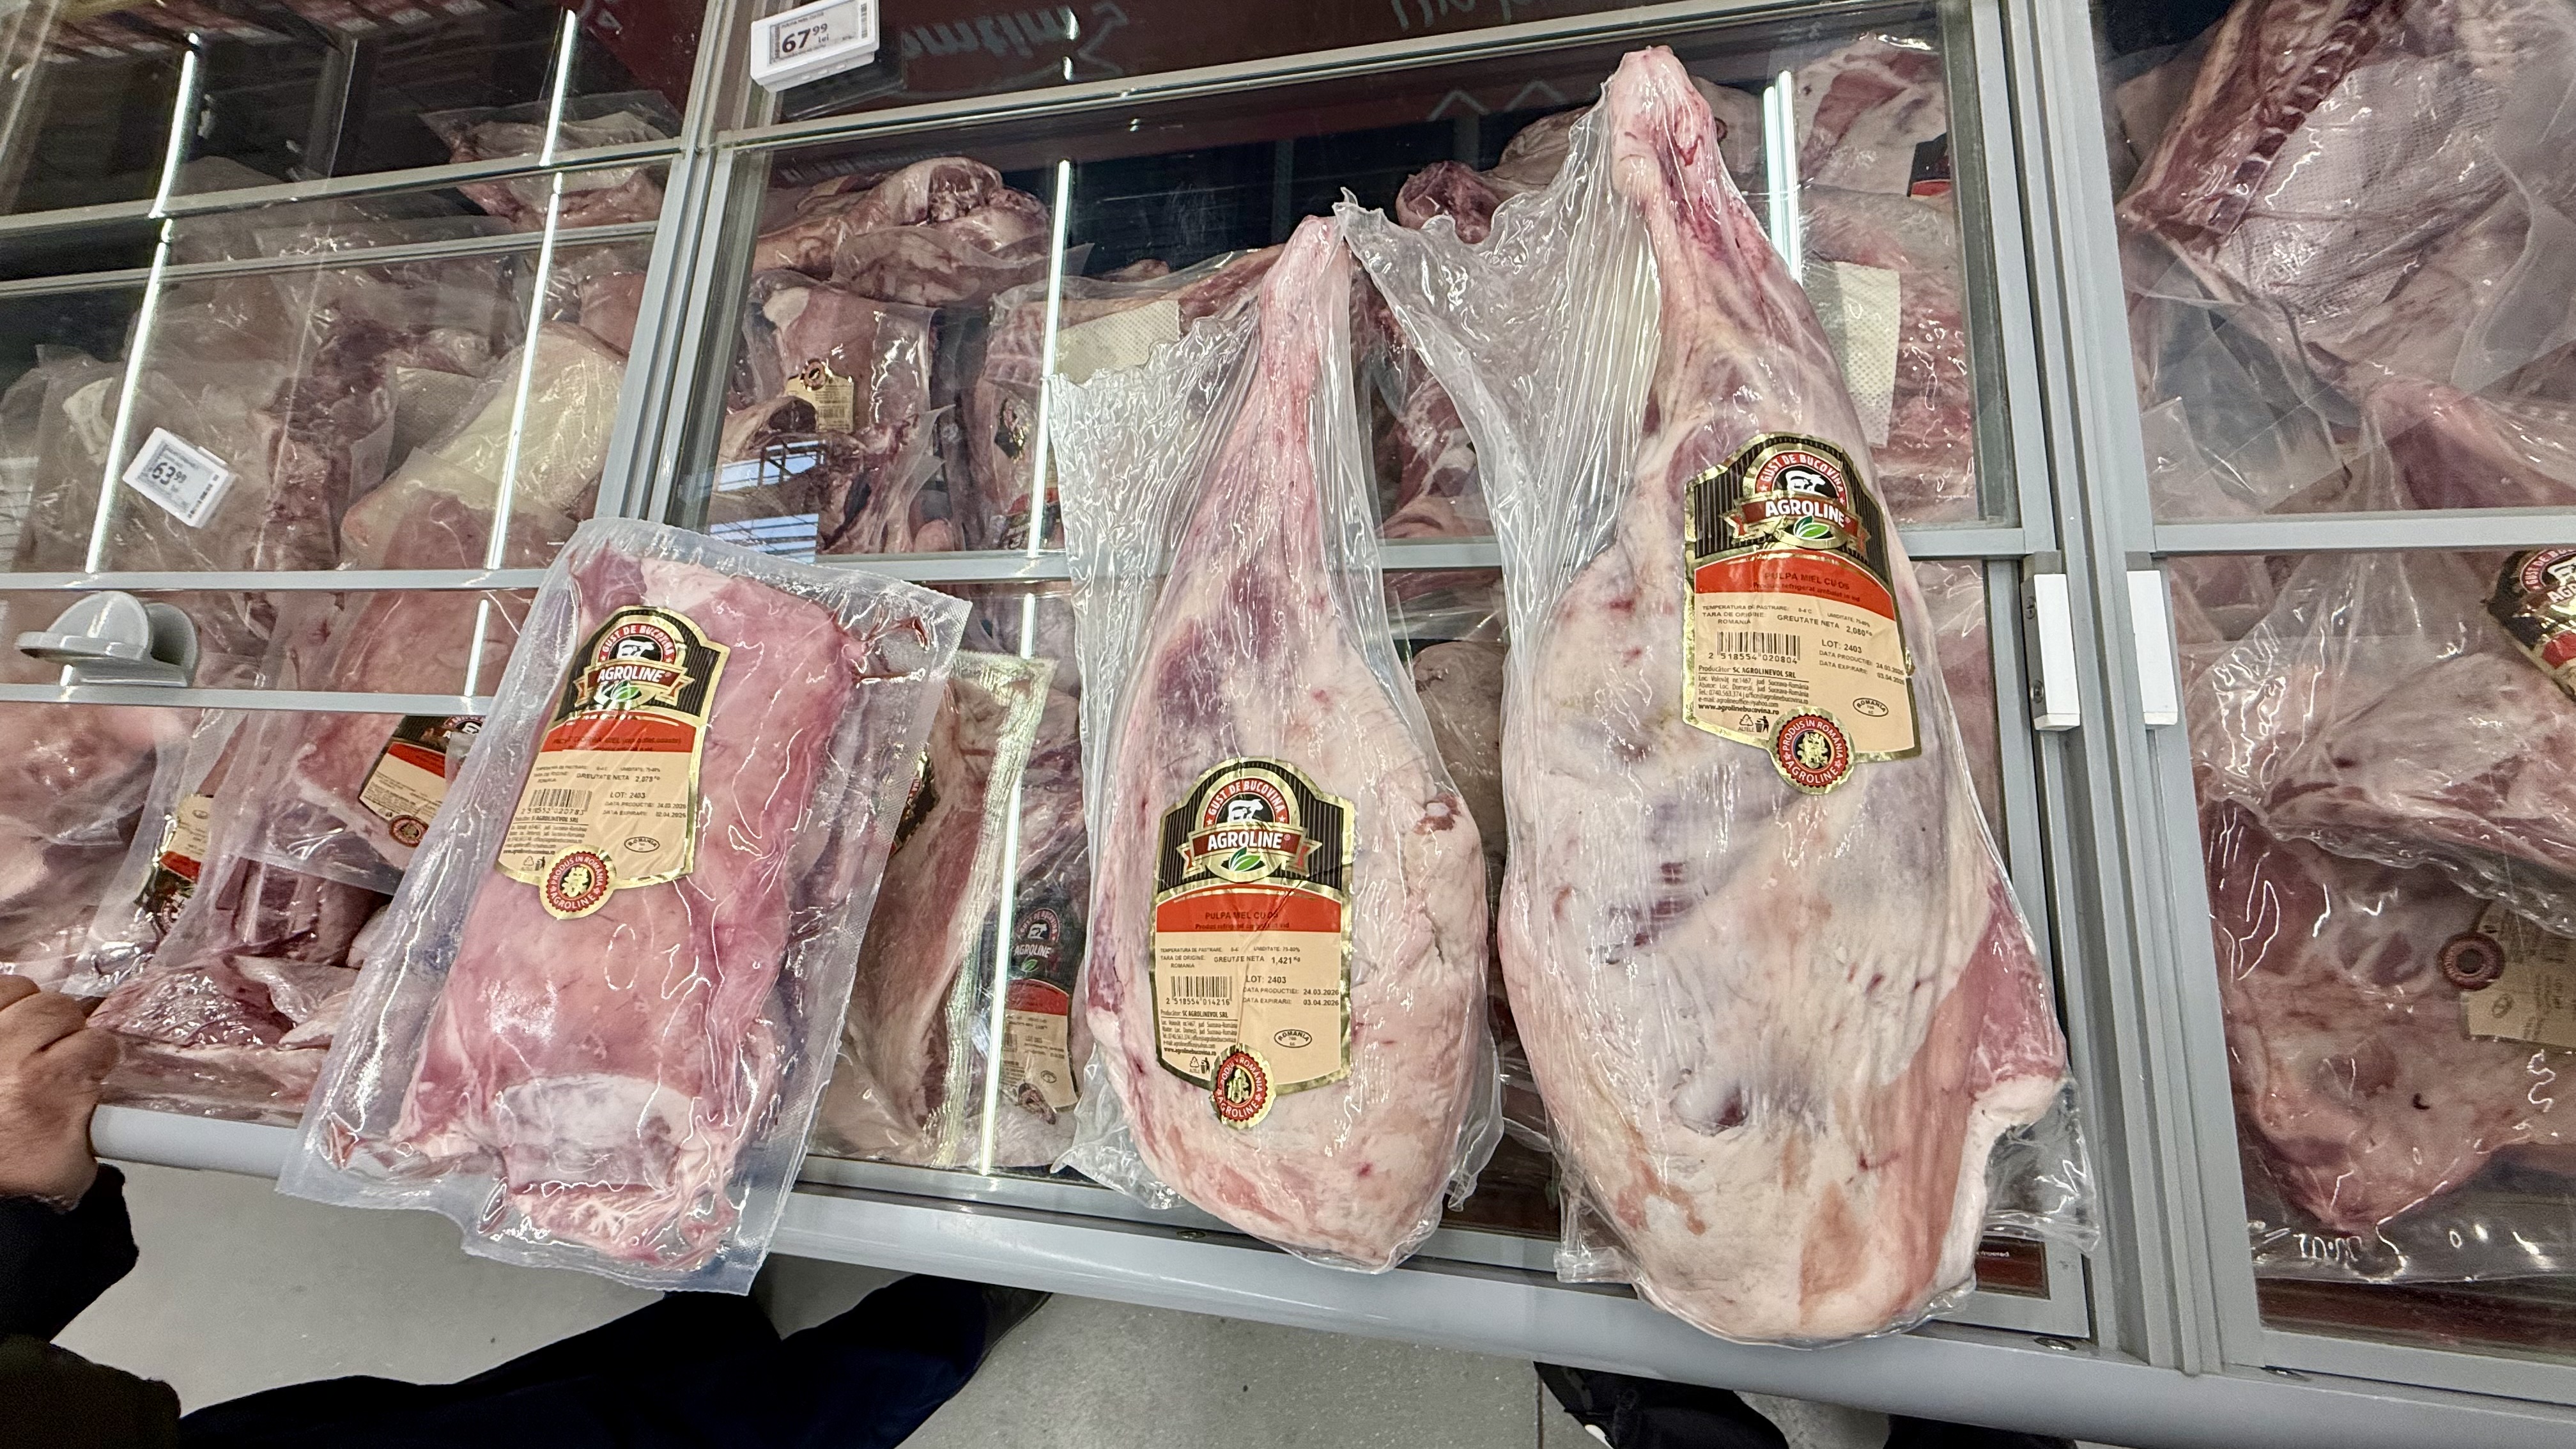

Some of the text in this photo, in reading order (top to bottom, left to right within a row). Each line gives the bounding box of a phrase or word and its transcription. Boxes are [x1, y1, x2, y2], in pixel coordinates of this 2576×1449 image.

[782, 28, 811, 53] 67
[152, 462, 176, 485] 63
[1760, 454, 1843, 492] GUST DE BUCOVINA
[1765, 499, 1845, 528] AGROLINE
[1801, 575, 1822, 584] MIEL
[1824, 578, 1837, 587] CU
[1838, 581, 1850, 590] OS
[1777, 614, 1840, 629] GREUTATE NETA
[602, 632, 621, 653] GUST
[624, 625, 636, 635] DE
[1844, 644, 1862, 653] 2403
[1762, 655, 1798, 664] 020804
[597, 665, 666, 683] AGROLINE
[1741, 667, 1784, 677] AGROLINEVOL
[1698, 704, 1780, 715] www.agrolinebucovina.ro
[1856, 700, 1886, 713] ROMANIA
[1783, 719, 1805, 751] PRODUS
[1817, 722, 1844, 759] ROMANIA
[1786, 761, 1839, 784] AGROLINE
[1208, 780, 1286, 816] GUST DE BUCOVINA
[1207, 831, 1283, 851] AGROLINE
[551, 858, 574, 885] PRODUS
[550, 892, 596, 909] AGROLINE
[1014, 944, 1052, 958] AGROLINE
[1278, 1031, 1309, 1042] ROMANIA
[1240, 1057, 1263, 1092] ROMANIA
[1217, 1096, 1260, 1117] AGROLINE
